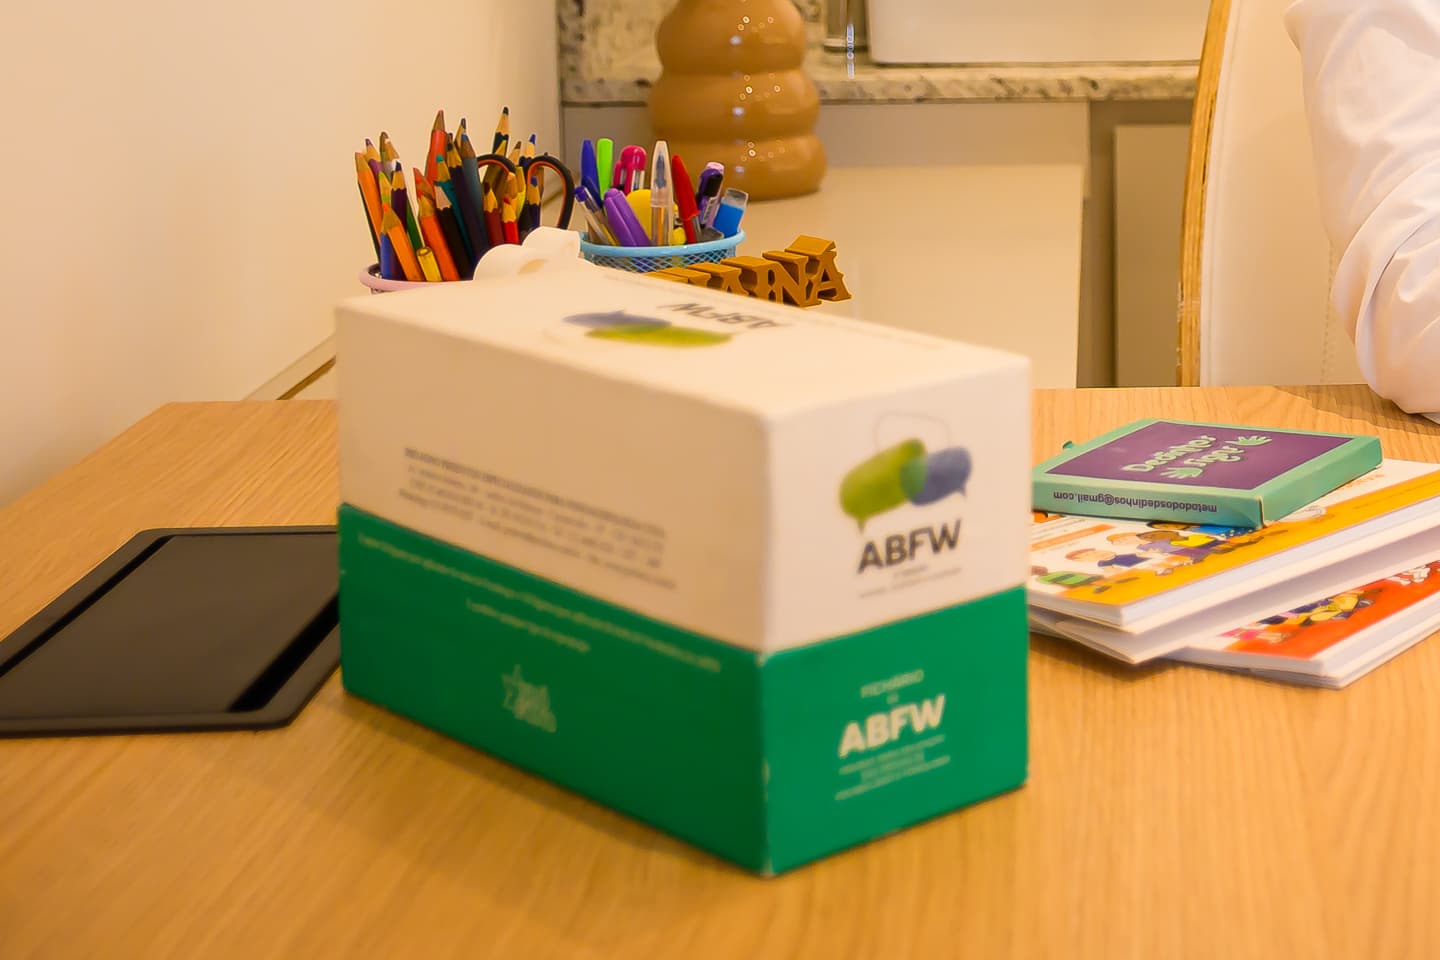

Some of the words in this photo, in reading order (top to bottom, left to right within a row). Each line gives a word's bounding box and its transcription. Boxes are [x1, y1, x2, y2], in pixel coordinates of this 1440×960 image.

[1053, 490, 1218, 514] metododosdedinhos@gmail.com
[856, 517, 963, 575] ABFW
[838, 693, 946, 759] ABFW
